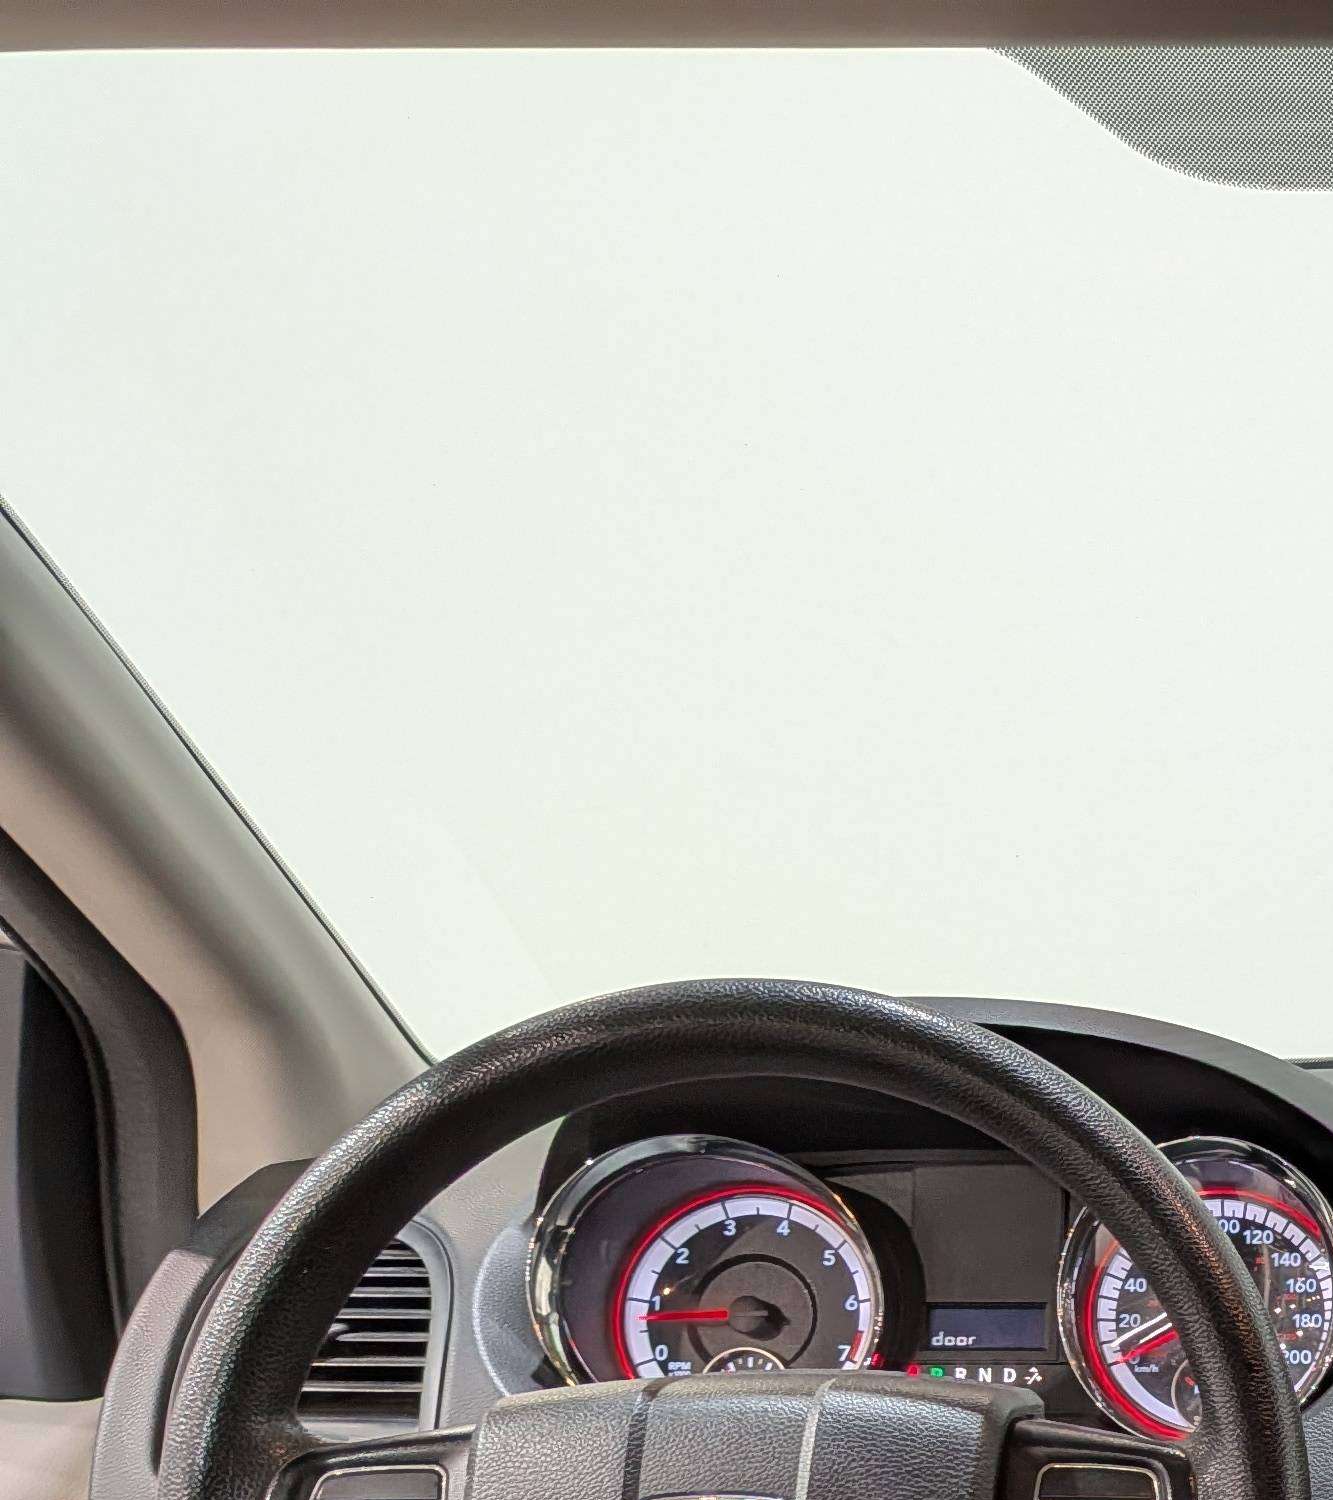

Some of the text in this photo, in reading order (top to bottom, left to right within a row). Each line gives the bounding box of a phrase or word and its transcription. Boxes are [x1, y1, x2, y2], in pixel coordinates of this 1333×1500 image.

[723, 1220, 737, 1236] 3
[776, 1220, 790, 1236] 4
[1218, 1219, 1240, 1234] 00
[1243, 1230, 1274, 1245] 120
[676, 1249, 690, 1264] 2
[823, 1250, 836, 1266] 5
[1271, 1252, 1301, 1267] 140
[1124, 1278, 1148, 1293] 40
[1287, 1279, 1317, 1293] 160
[652, 1296, 661, 1311] 1
[845, 1296, 858, 1311] 6
[1119, 1314, 1141, 1328] 20
[1292, 1315, 1322, 1329] 180
[931, 1331, 976, 1346] door
[655, 1345, 668, 1361] 0
[837, 1345, 851, 1361] 7
[668, 1361, 691, 1370] RPM
[1135, 1364, 1159, 1373] km/h
[979, 1368, 992, 1382] N
[1004, 1368, 1017, 1382] D
